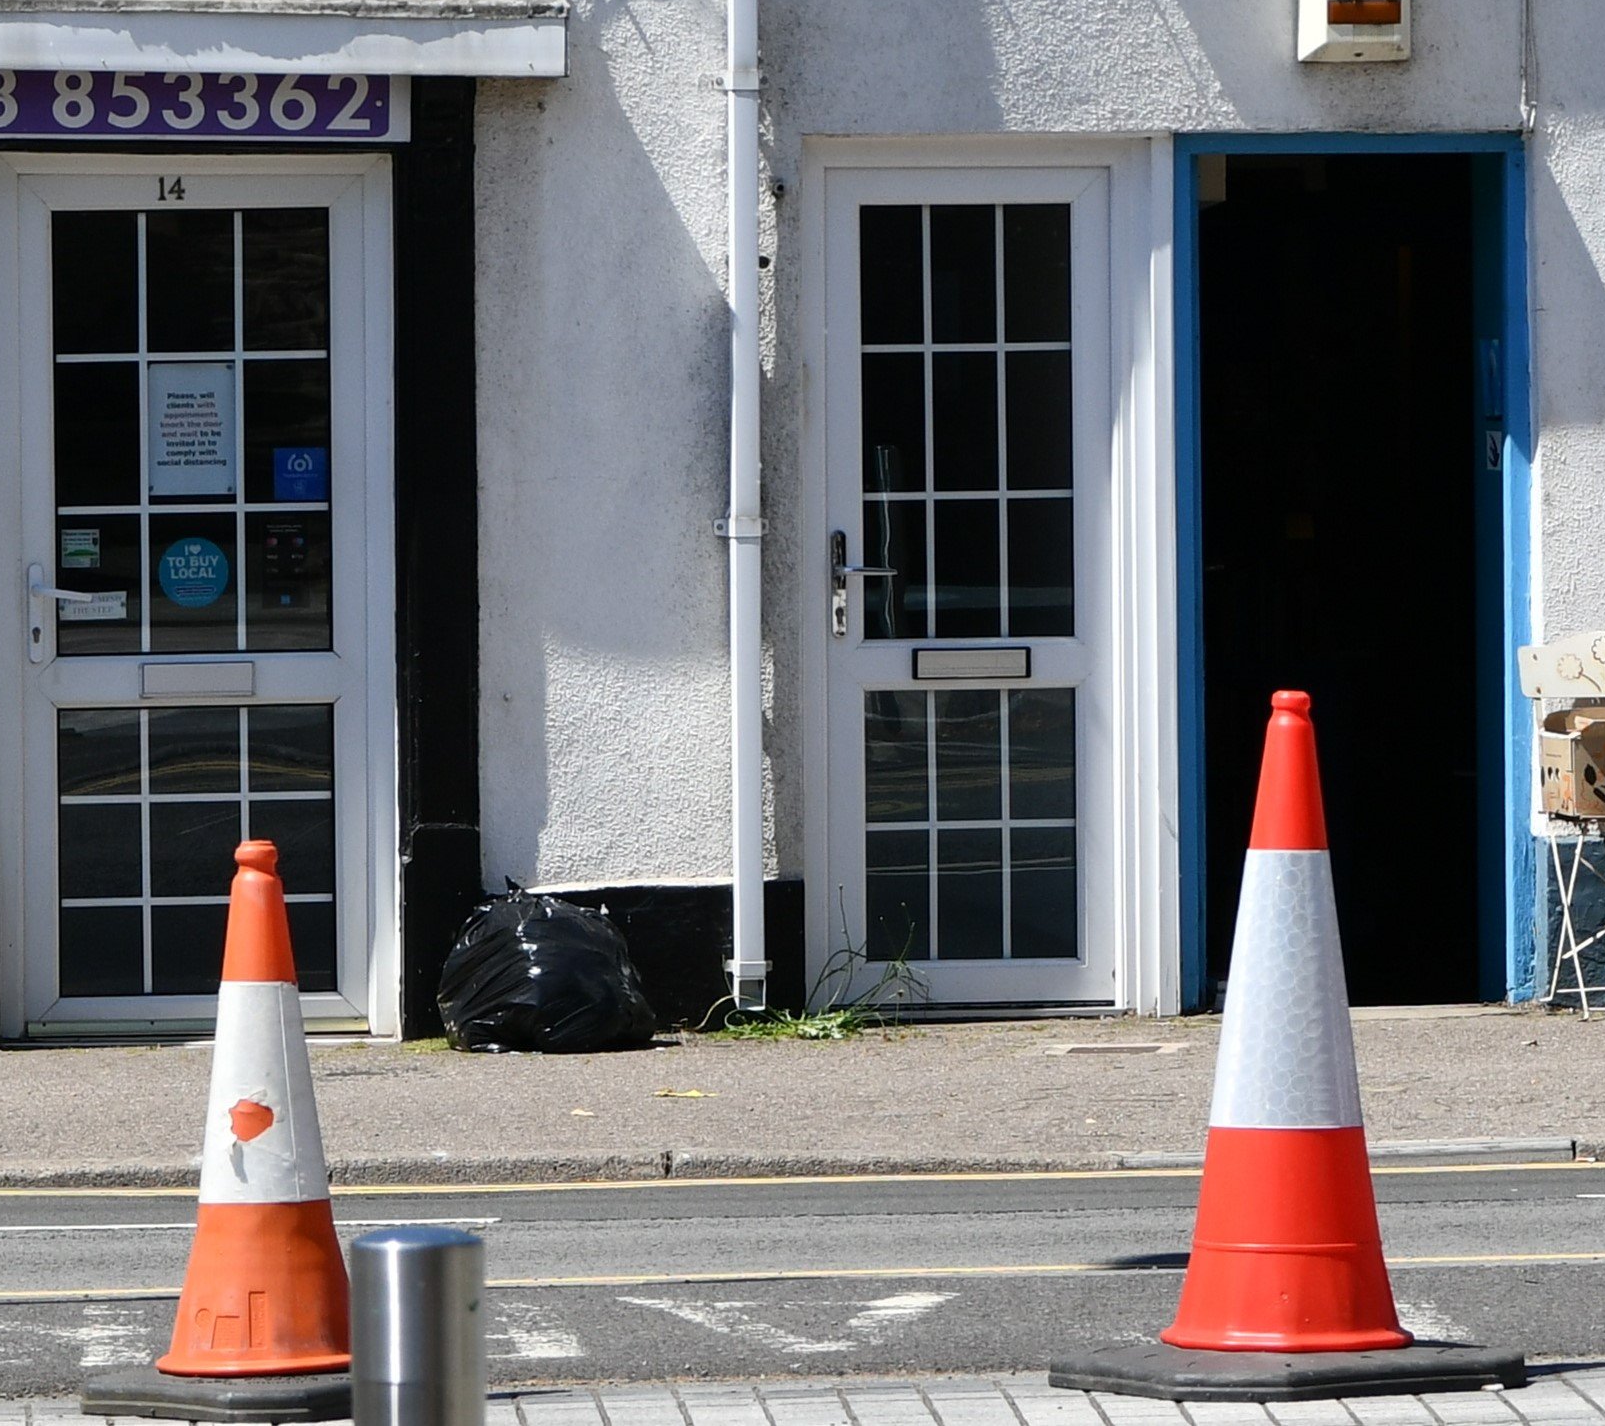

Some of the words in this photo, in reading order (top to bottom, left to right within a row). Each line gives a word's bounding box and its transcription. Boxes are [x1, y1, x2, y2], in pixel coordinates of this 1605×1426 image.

[52, 72, 371, 131] 853362
[157, 176, 185, 201] 14
[166, 449, 196, 457] comply
[167, 556, 185, 567] TO
[189, 555, 219, 567] BUY
[171, 567, 216, 579] LOCAL
